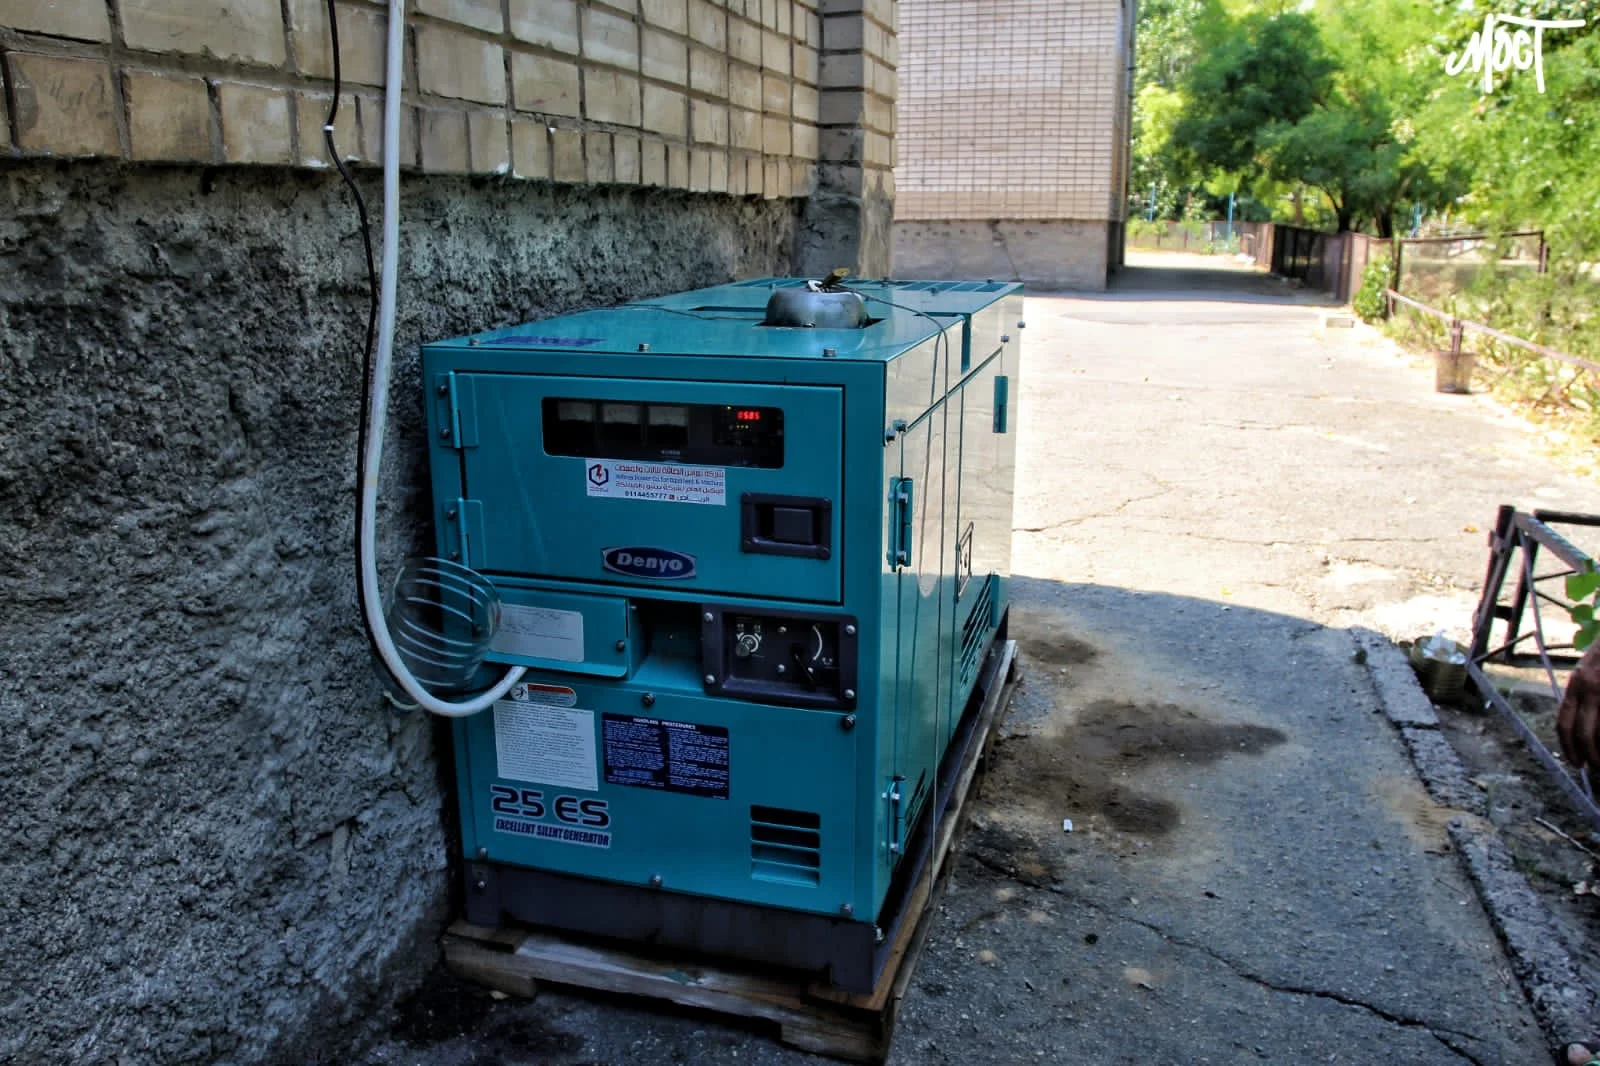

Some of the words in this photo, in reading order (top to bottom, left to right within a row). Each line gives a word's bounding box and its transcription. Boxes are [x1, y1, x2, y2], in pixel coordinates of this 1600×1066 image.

[616, 552, 683, 573] Denyo
[491, 785, 545, 818] 25
[554, 795, 610, 828] ES
[495, 819, 536, 835] EXCELLENT
[536, 823, 564, 841] SILENT
[563, 828, 610, 847] GENERATOR
